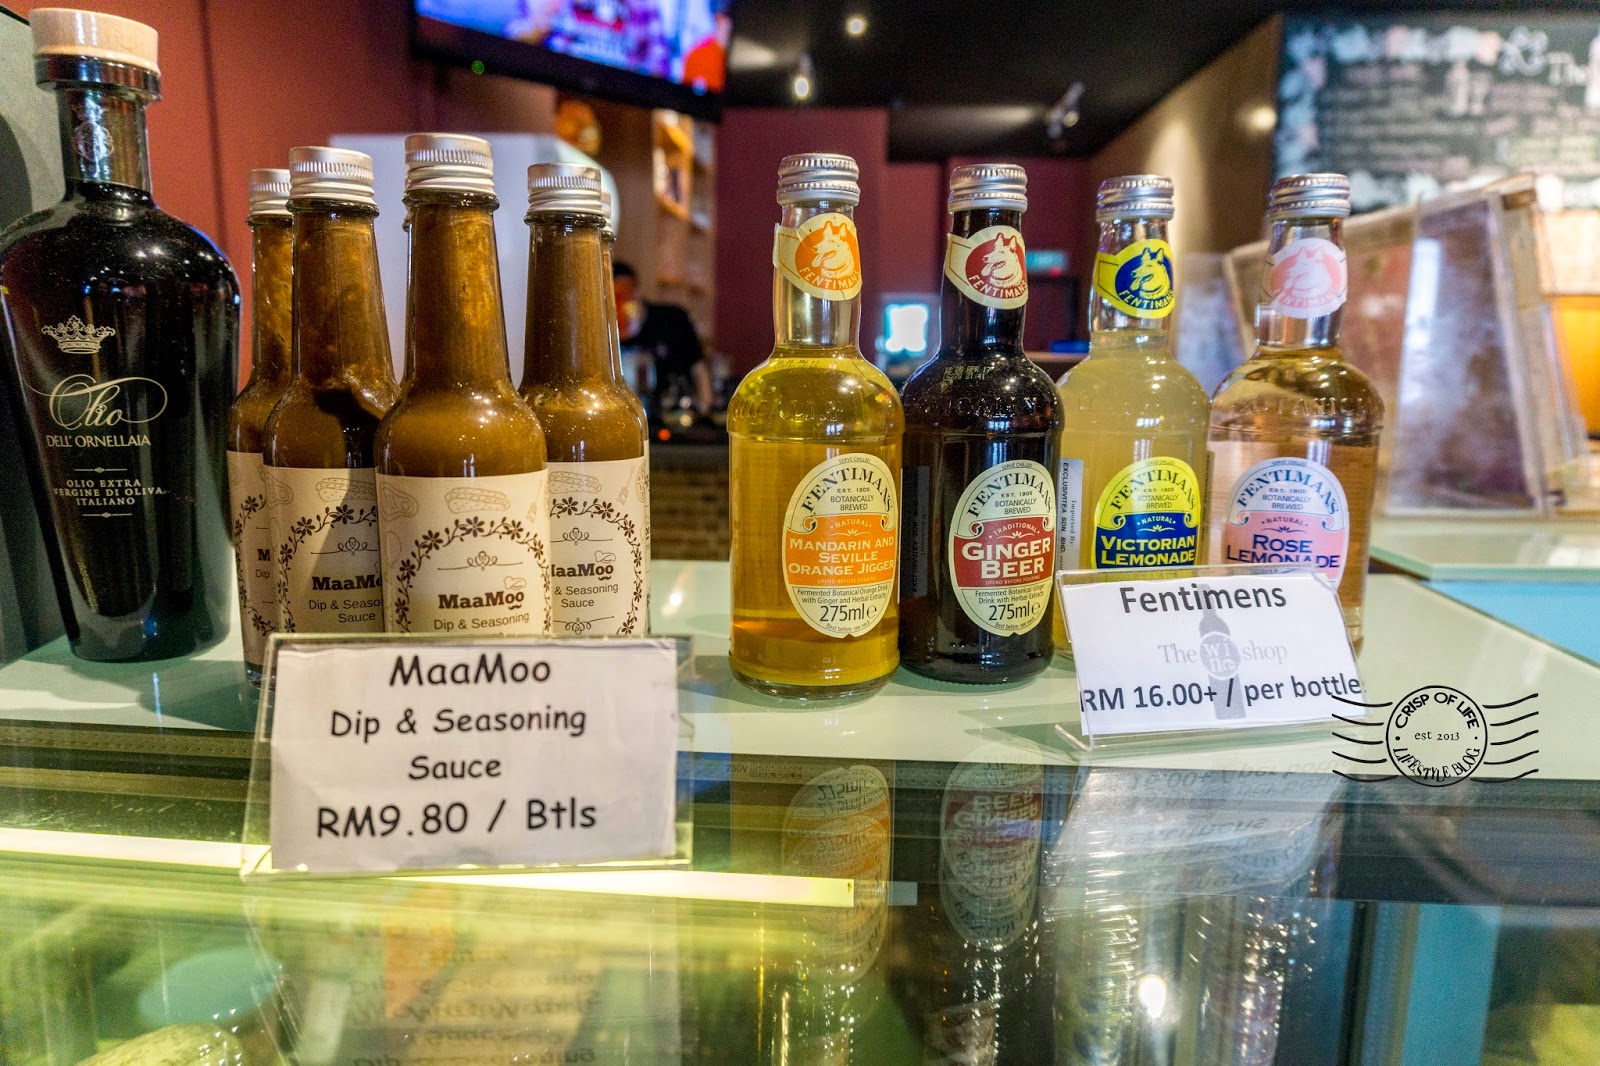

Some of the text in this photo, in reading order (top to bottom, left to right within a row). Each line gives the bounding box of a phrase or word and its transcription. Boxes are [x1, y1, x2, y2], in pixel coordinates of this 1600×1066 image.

[75, 434, 152, 447] ORNELLAIA
[66, 479, 141, 488] OLIO EXTRA
[1061, 462, 1069, 513] EXCLUSIVITEA
[52, 488, 100, 497] VERGINE
[106, 488, 119, 496] DI
[1263, 494, 1312, 502] BOTANICALLY
[77, 497, 135, 506] ITALIANO
[995, 498, 1037, 507] BOTANICALLY
[834, 518, 869, 529] NATURAL
[1141, 516, 1173, 525] NATURAL
[1266, 517, 1304, 526] NATURAL
[993, 523, 1037, 536] TRADITIONAL
[789, 536, 894, 551] MANDARIN AND
[962, 537, 1051, 561] GINGER
[1101, 535, 1195, 551] VICTORIAN
[1252, 534, 1312, 553] ROSE
[818, 551, 878, 564] SEVILLE
[1101, 550, 1195, 566] LEMONADE
[788, 559, 894, 576] ORANGE JIGGER
[982, 557, 1044, 578] BEER
[554, 582, 619, 596] & Seasoning
[832, 588, 859, 596] Botanical
[860, 587, 877, 595] Orange
[309, 599, 383, 612] Dip & Seaso
[438, 590, 524, 609] MaaMoo
[561, 598, 595, 608] Sauce
[817, 597, 838, 605] Ginger
[1119, 582, 1287, 614] Fentimens
[338, 612, 376, 623] Sauce
[820, 603, 864, 622] 275ml
[989, 601, 1030, 620] 275ml
[434, 611, 530, 632] Dip & Seasoning
[1157, 643, 1197, 664] The
[1242, 641, 1287, 664] shop
[389, 653, 552, 687] MaaMoo
[1080, 672, 1362, 712] RM 16.00+ / per bottle
[330, 705, 586, 744] Dip & Seasoning
[408, 755, 503, 781] Sauce
[316, 798, 597, 839] RM9.80 / Btls
